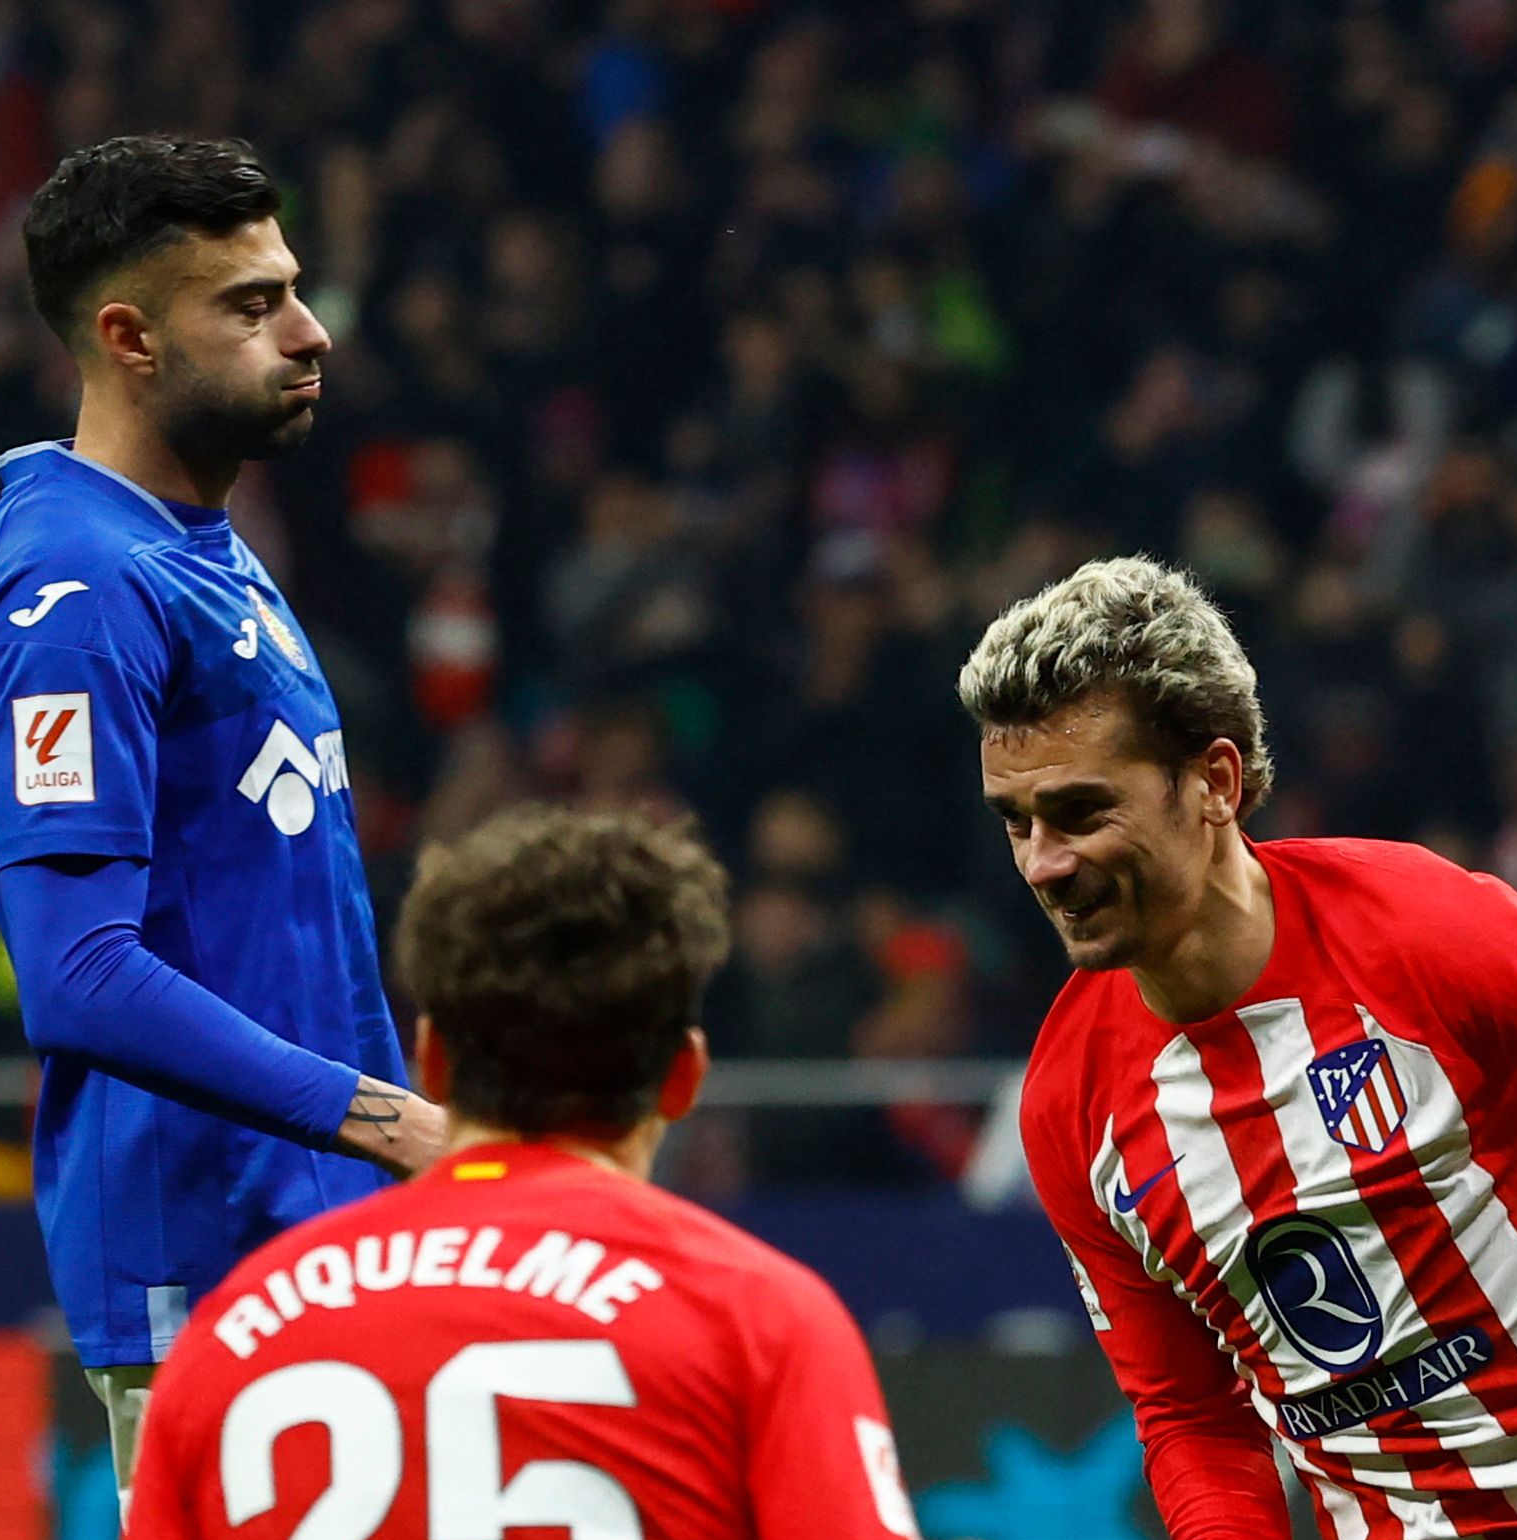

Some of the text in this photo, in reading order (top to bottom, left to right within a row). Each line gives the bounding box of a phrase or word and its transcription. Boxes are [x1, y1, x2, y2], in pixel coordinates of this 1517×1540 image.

[25, 771, 83, 790] LALIGA
[213, 1226, 664, 1360] RIQUELME
[1280, 1334, 1488, 1436] RIYADH AIR
